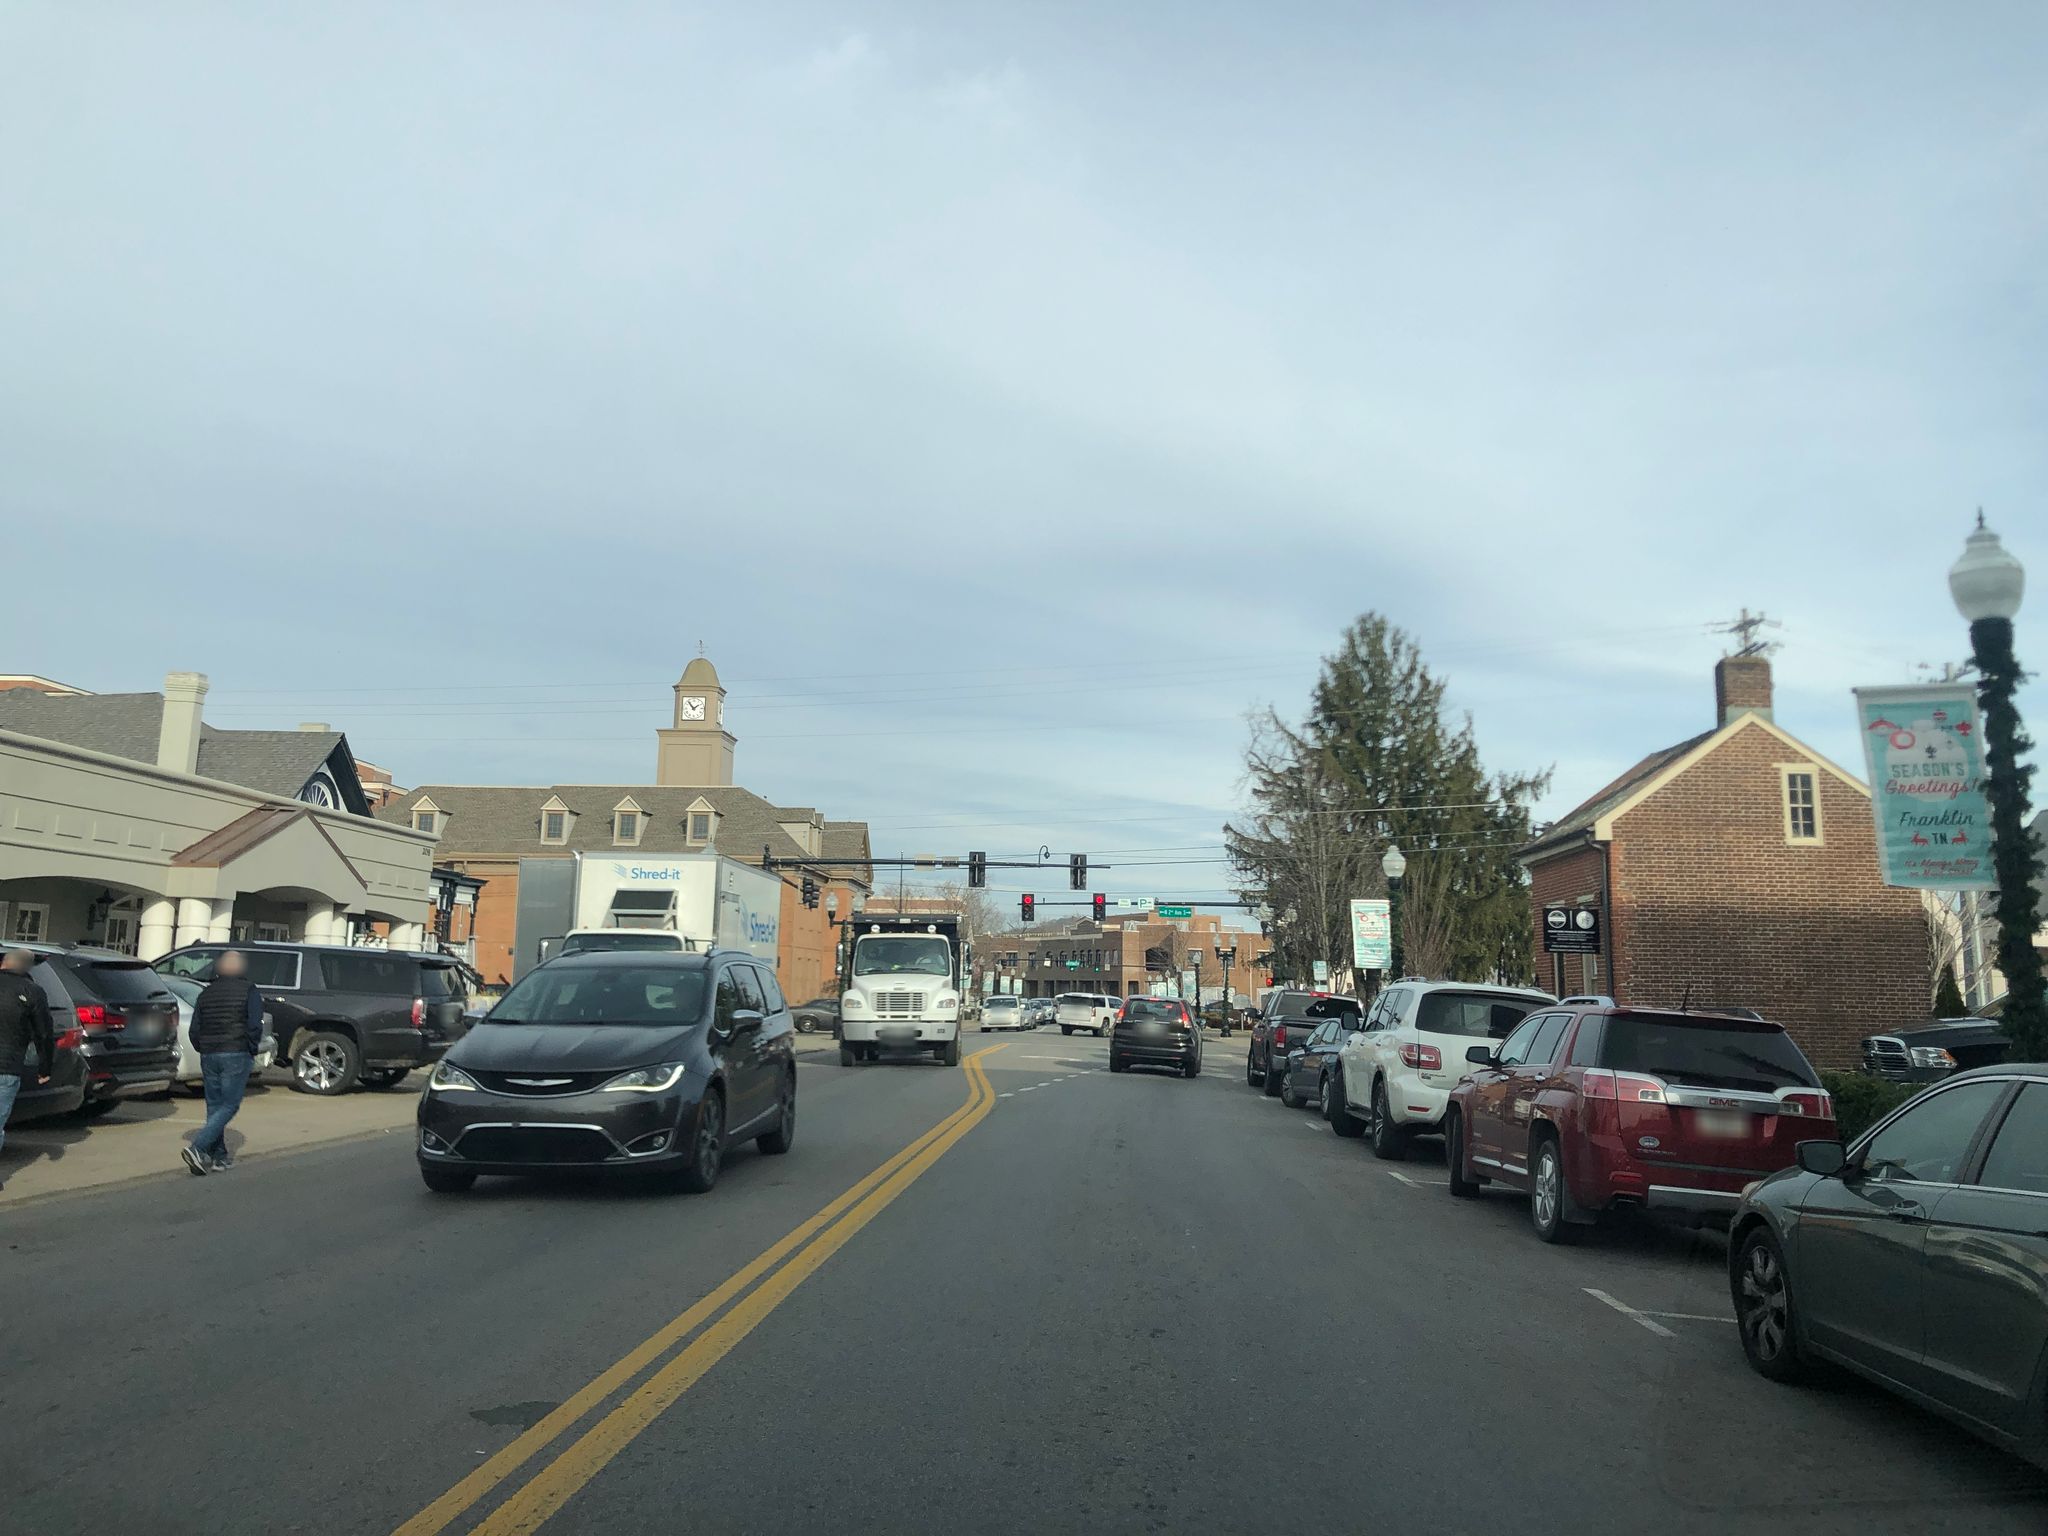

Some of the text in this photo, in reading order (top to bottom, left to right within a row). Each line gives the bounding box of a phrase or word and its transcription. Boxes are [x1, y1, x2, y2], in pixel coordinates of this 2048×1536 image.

[1891, 762, 1965, 778] SEASON'S
[1899, 809, 1974, 827] Franklin
[1932, 832, 1949, 845] TN
[631, 867, 681, 880] Shred-it
[1708, 1097, 1739, 1107] GMC
